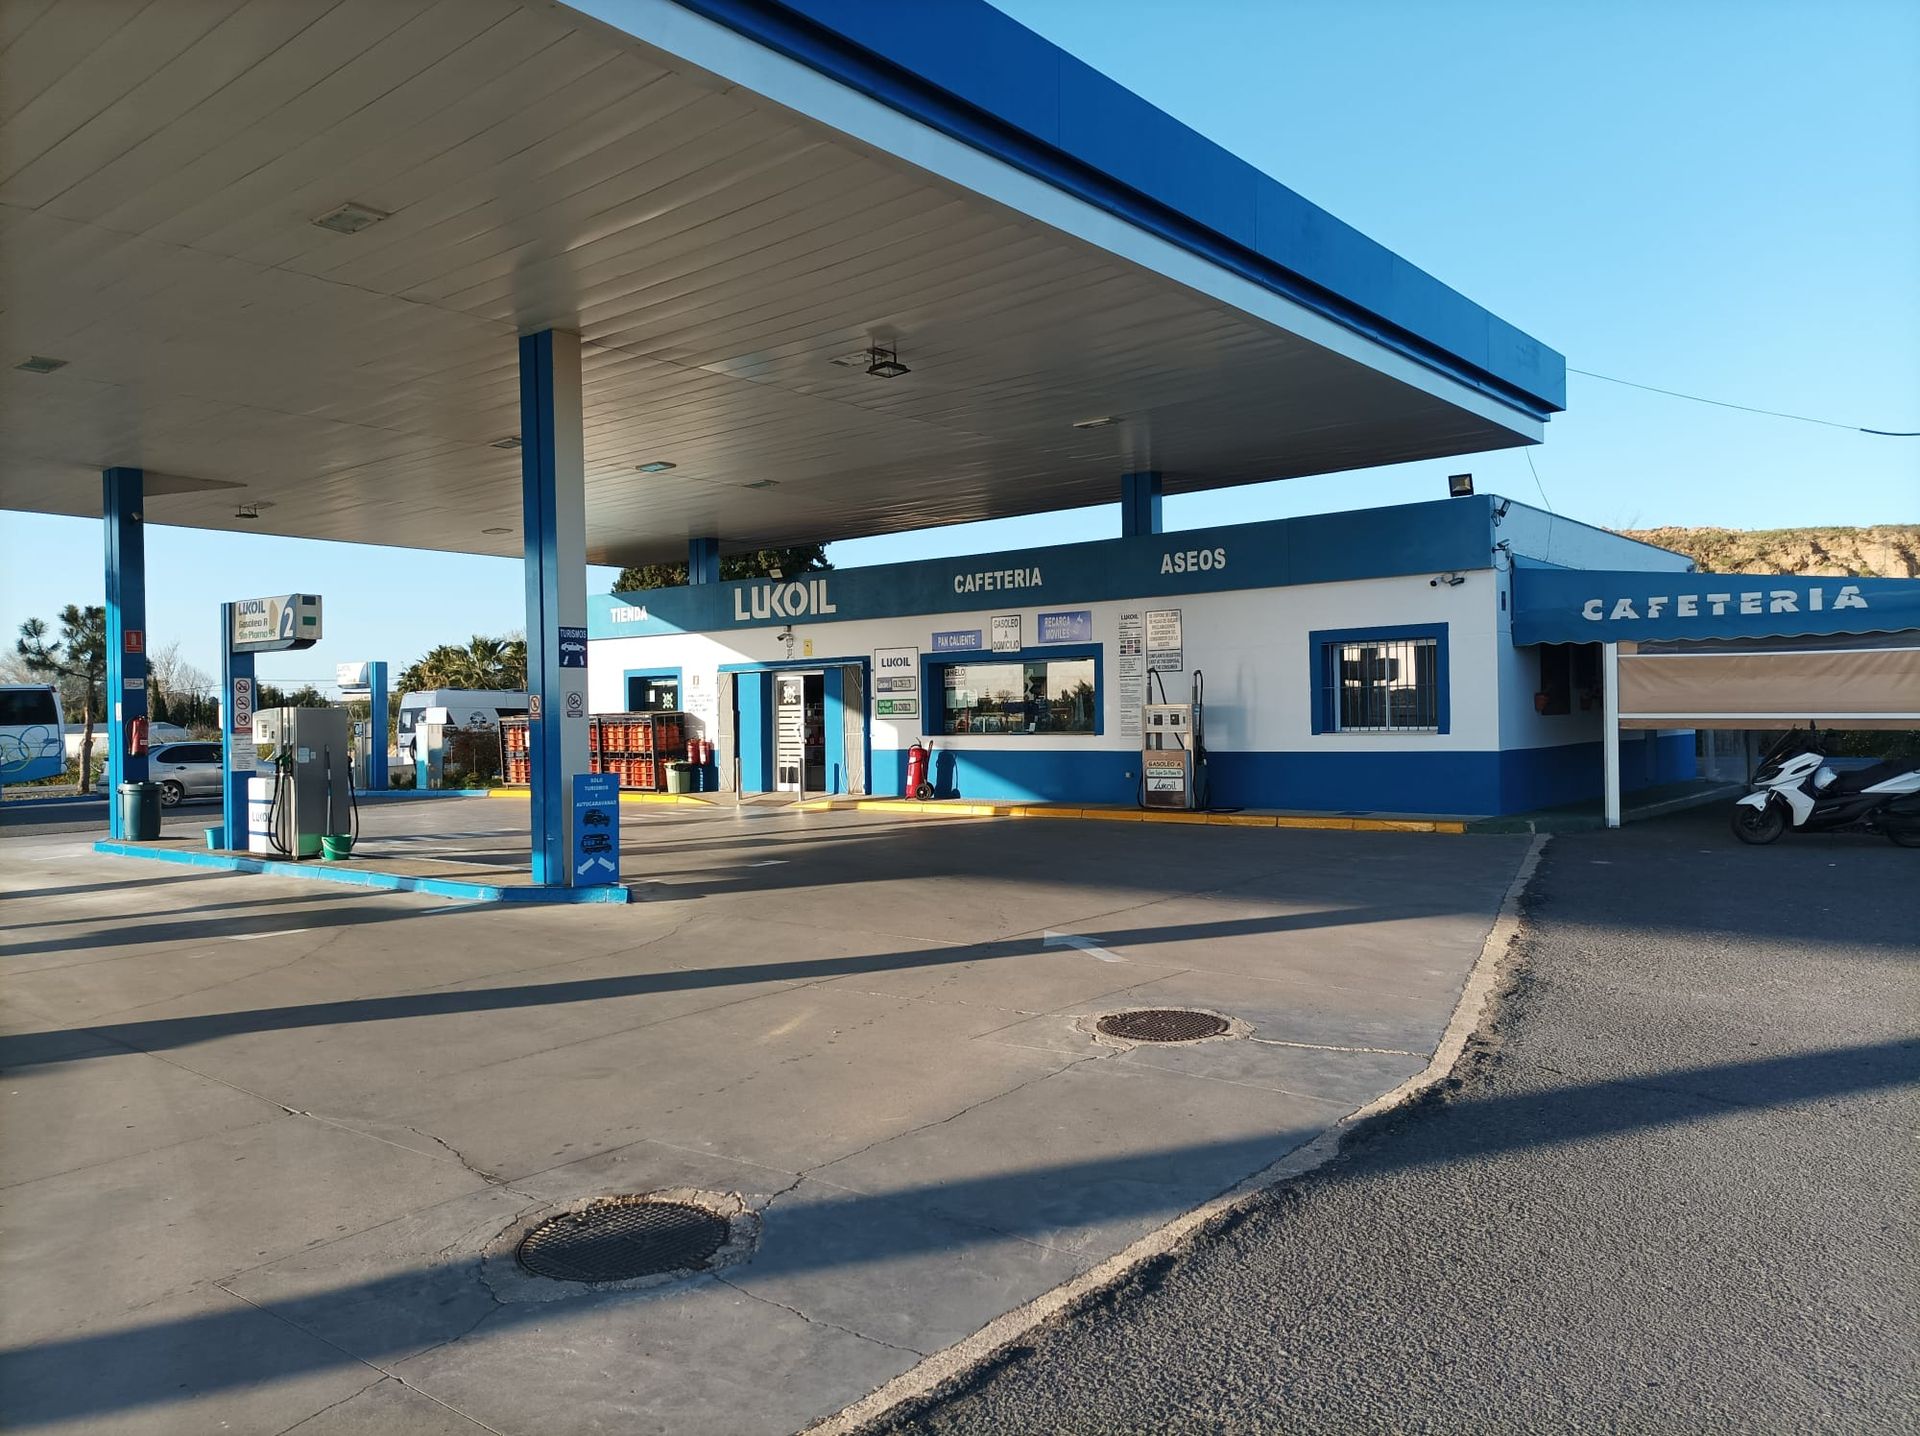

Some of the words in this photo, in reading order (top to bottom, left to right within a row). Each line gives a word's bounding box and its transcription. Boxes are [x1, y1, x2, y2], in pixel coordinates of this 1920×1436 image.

[1160, 548, 1226, 574] ASEOS
[954, 567, 1043, 594] CAFETERIA
[734, 579, 837, 621] LUKOIL
[1581, 585, 1869, 621] CAFETERIA
[238, 600, 266, 616] LUKOIL
[610, 605, 648, 623] TIENDA
[283, 606, 294, 637] 2
[993, 618, 1019, 628] GASOLEO
[1044, 615, 1070, 628] RECARGA
[560, 628, 587, 639] TURISMOS
[1004, 630, 1009, 639] A
[1045, 628, 1070, 639] MOVILES
[937, 636, 949, 647] PAN
[949, 634, 976, 646] CALIENTE
[992, 640, 1020, 651] DOMICILIO
[881, 657, 911, 668] LUKOIL
